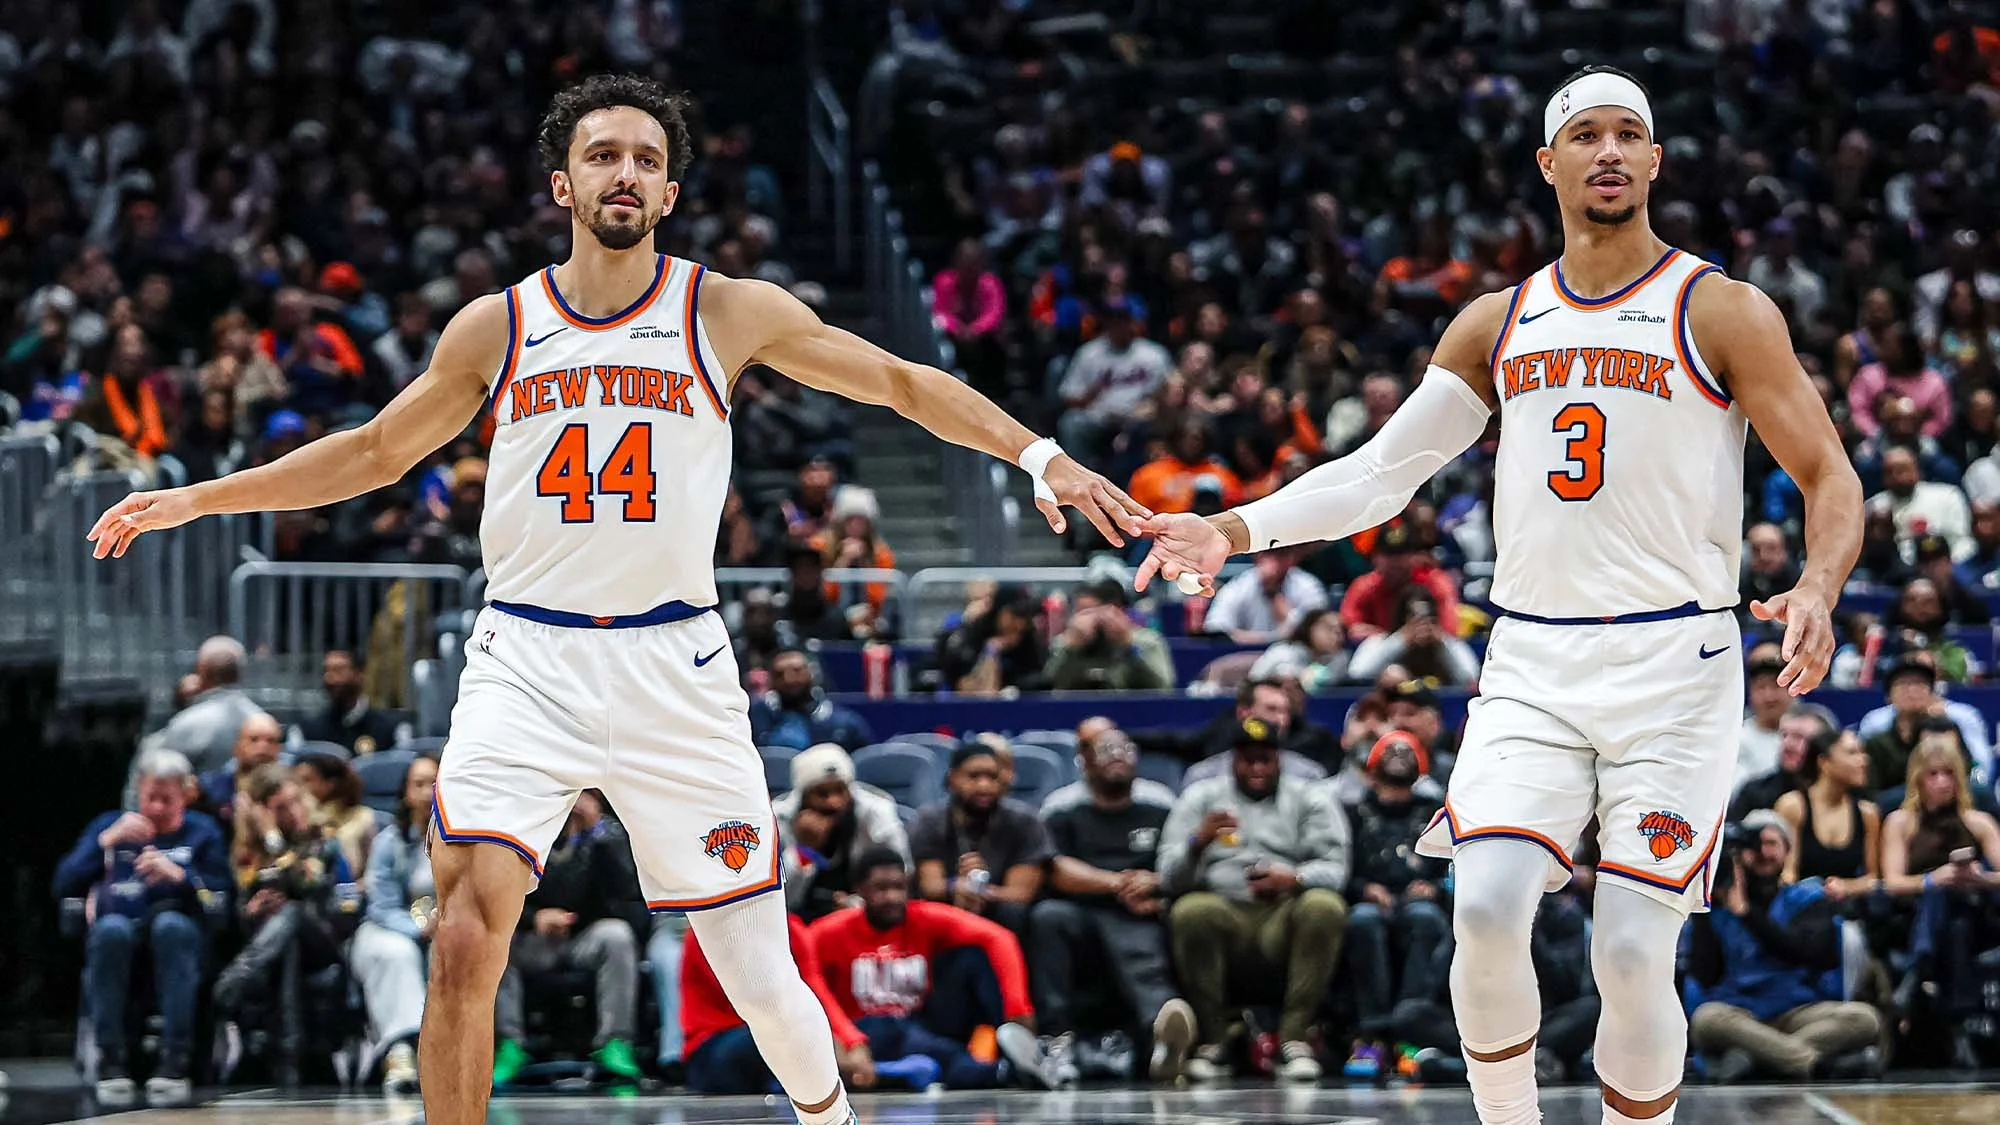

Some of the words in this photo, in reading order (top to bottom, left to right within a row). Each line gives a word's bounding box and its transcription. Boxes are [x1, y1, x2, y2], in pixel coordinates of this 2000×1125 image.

[629, 331, 650, 339] abu
[650, 329, 680, 338] dhabi
[1637, 315, 1666, 324] dhabi
[511, 366, 591, 423] NEW
[594, 365, 694, 418] YORK
[1502, 348, 1577, 402] NEW
[1579, 347, 1675, 402] YORK
[536, 422, 656, 524] 44
[1547, 402, 1607, 502] 3
[704, 823, 761, 855] KNICKS
[1637, 812, 1693, 848] KNICKS
